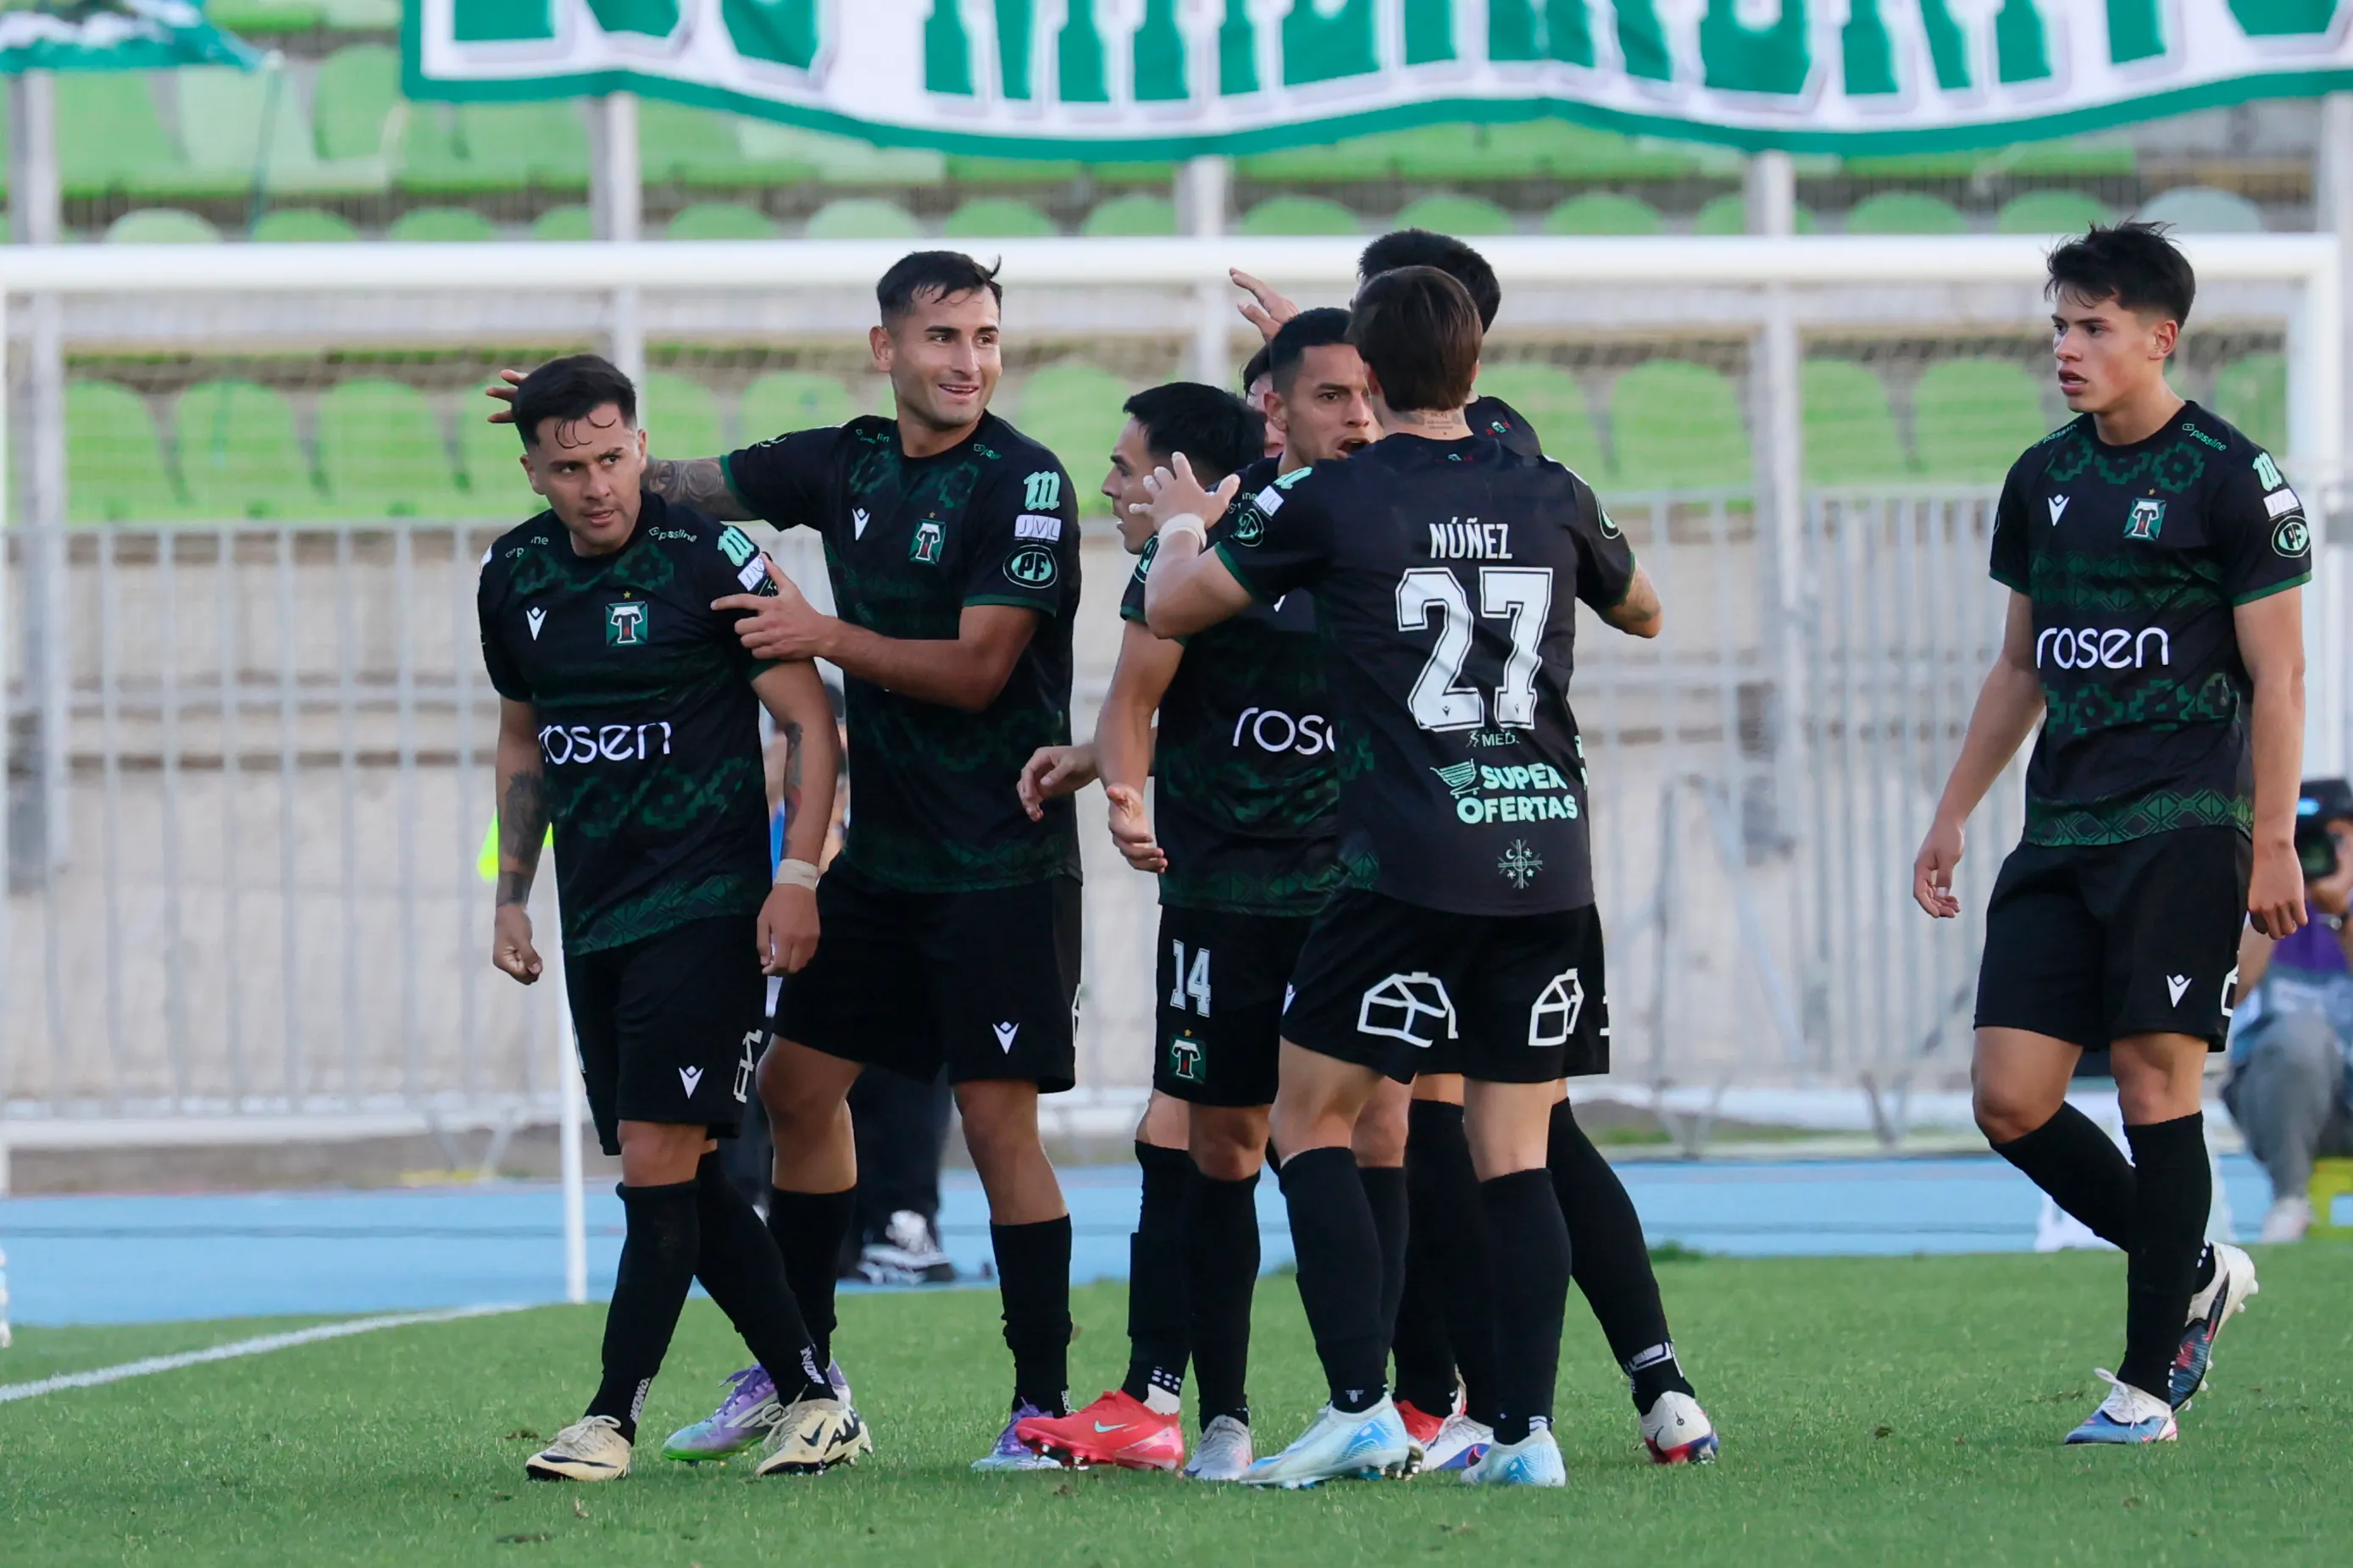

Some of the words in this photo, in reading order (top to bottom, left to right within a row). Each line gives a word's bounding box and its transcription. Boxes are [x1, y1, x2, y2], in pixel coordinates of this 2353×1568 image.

[1017, 517, 1060, 540] JVL
[1429, 516, 1513, 559] NÚÑEZ
[1395, 566, 1554, 732] 27
[2036, 626, 2169, 670] rosen
[1232, 706, 1335, 756] ros
[1479, 762, 1568, 790] SUPER
[1456, 794, 1579, 824] OFERTAS
[1169, 938, 1212, 1018] 14
